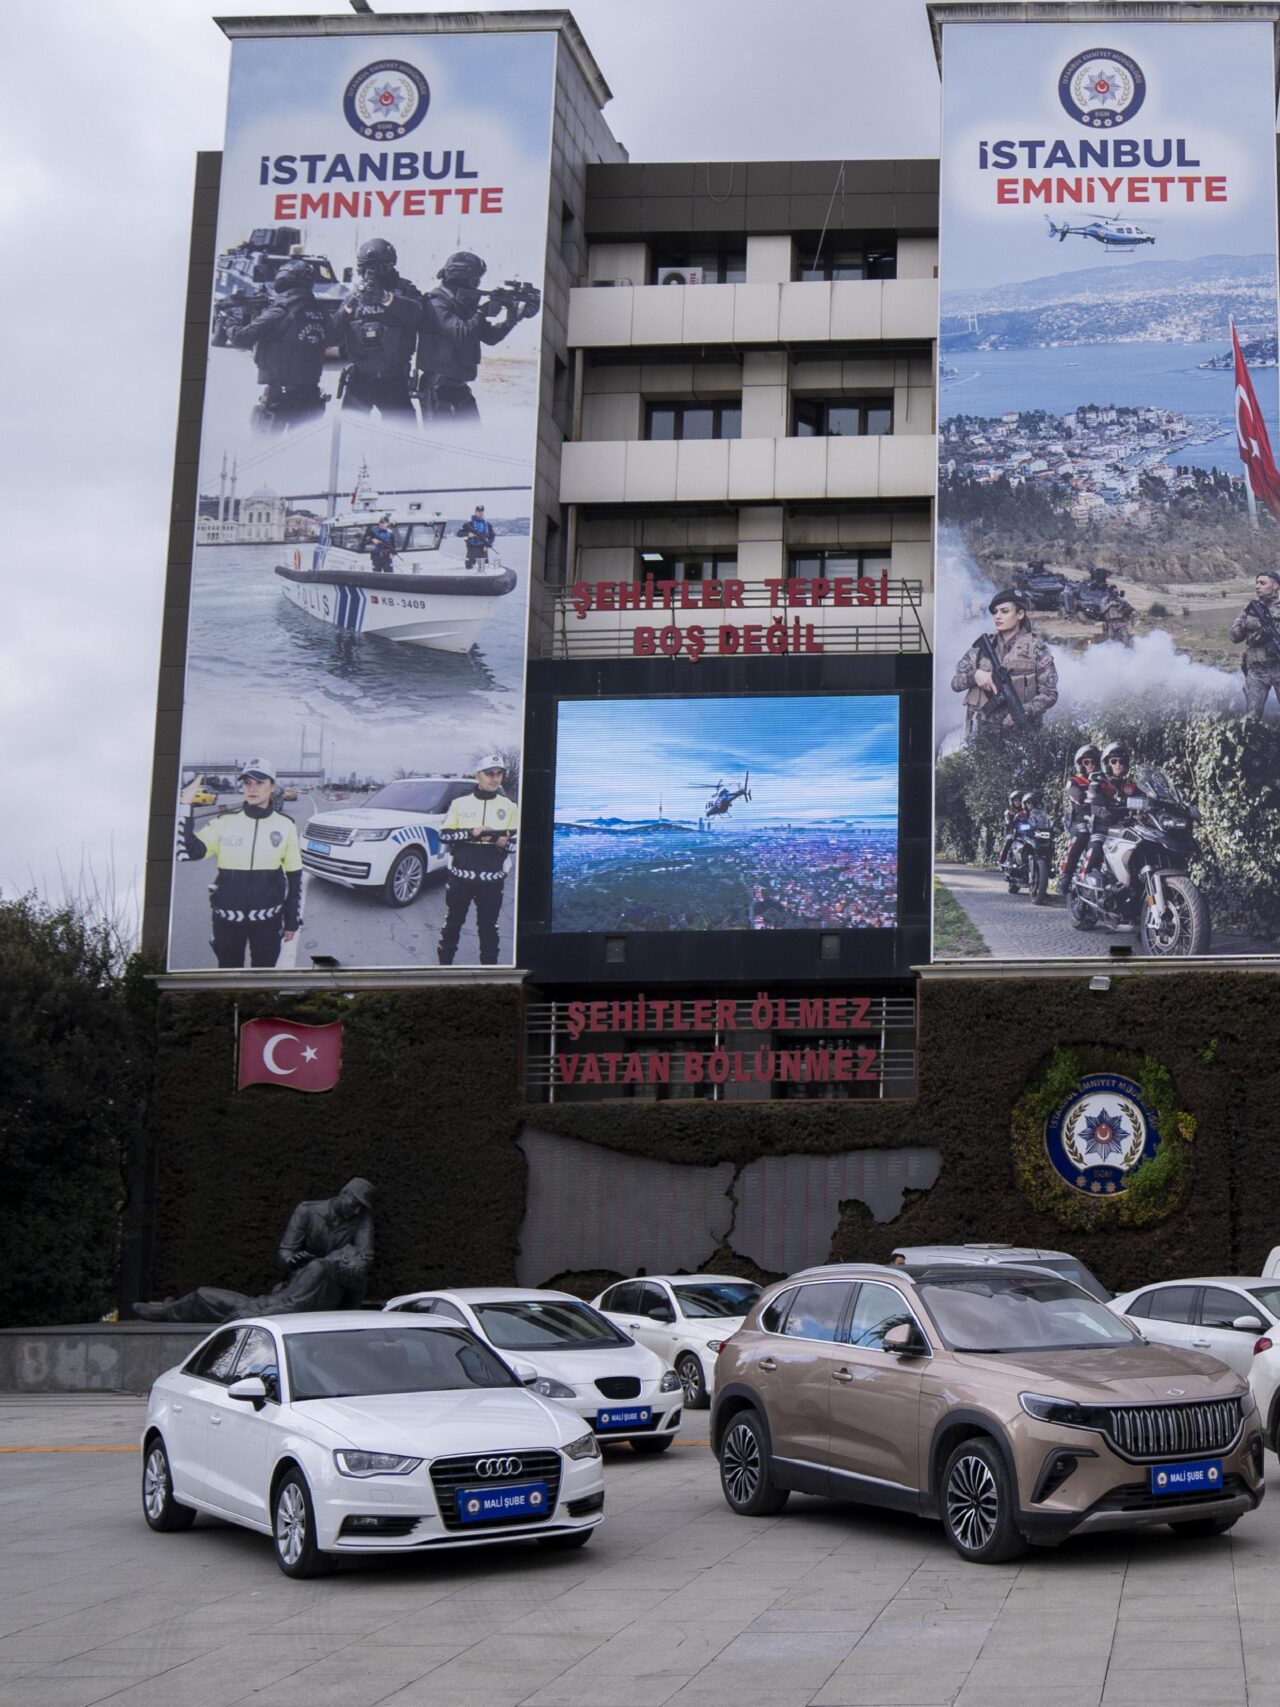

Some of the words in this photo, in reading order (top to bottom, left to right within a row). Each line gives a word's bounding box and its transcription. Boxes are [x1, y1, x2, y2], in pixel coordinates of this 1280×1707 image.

[273, 186, 504, 221] EMNİYETTE
[996, 174, 1228, 205] EMNİYETTE
[572, 571, 745, 620] ŞEHİTLER
[764, 568, 889, 607] TEPESİ
[633, 624, 705, 663] BOŞ
[718, 614, 824, 654] DEĞİL
[566, 992, 738, 1041] ŞEHİTLER
[750, 991, 872, 1032] ÖLMEZ
[557, 1050, 671, 1085] VATAN
[683, 1045, 879, 1084] BÖLÜNMEZ
[1170, 1471, 1186, 1482] MALİ
[1187, 1470, 1204, 1483] ŞUBE
[483, 1496, 503, 1509] MALİ
[504, 1495, 526, 1509] ŞUBE
